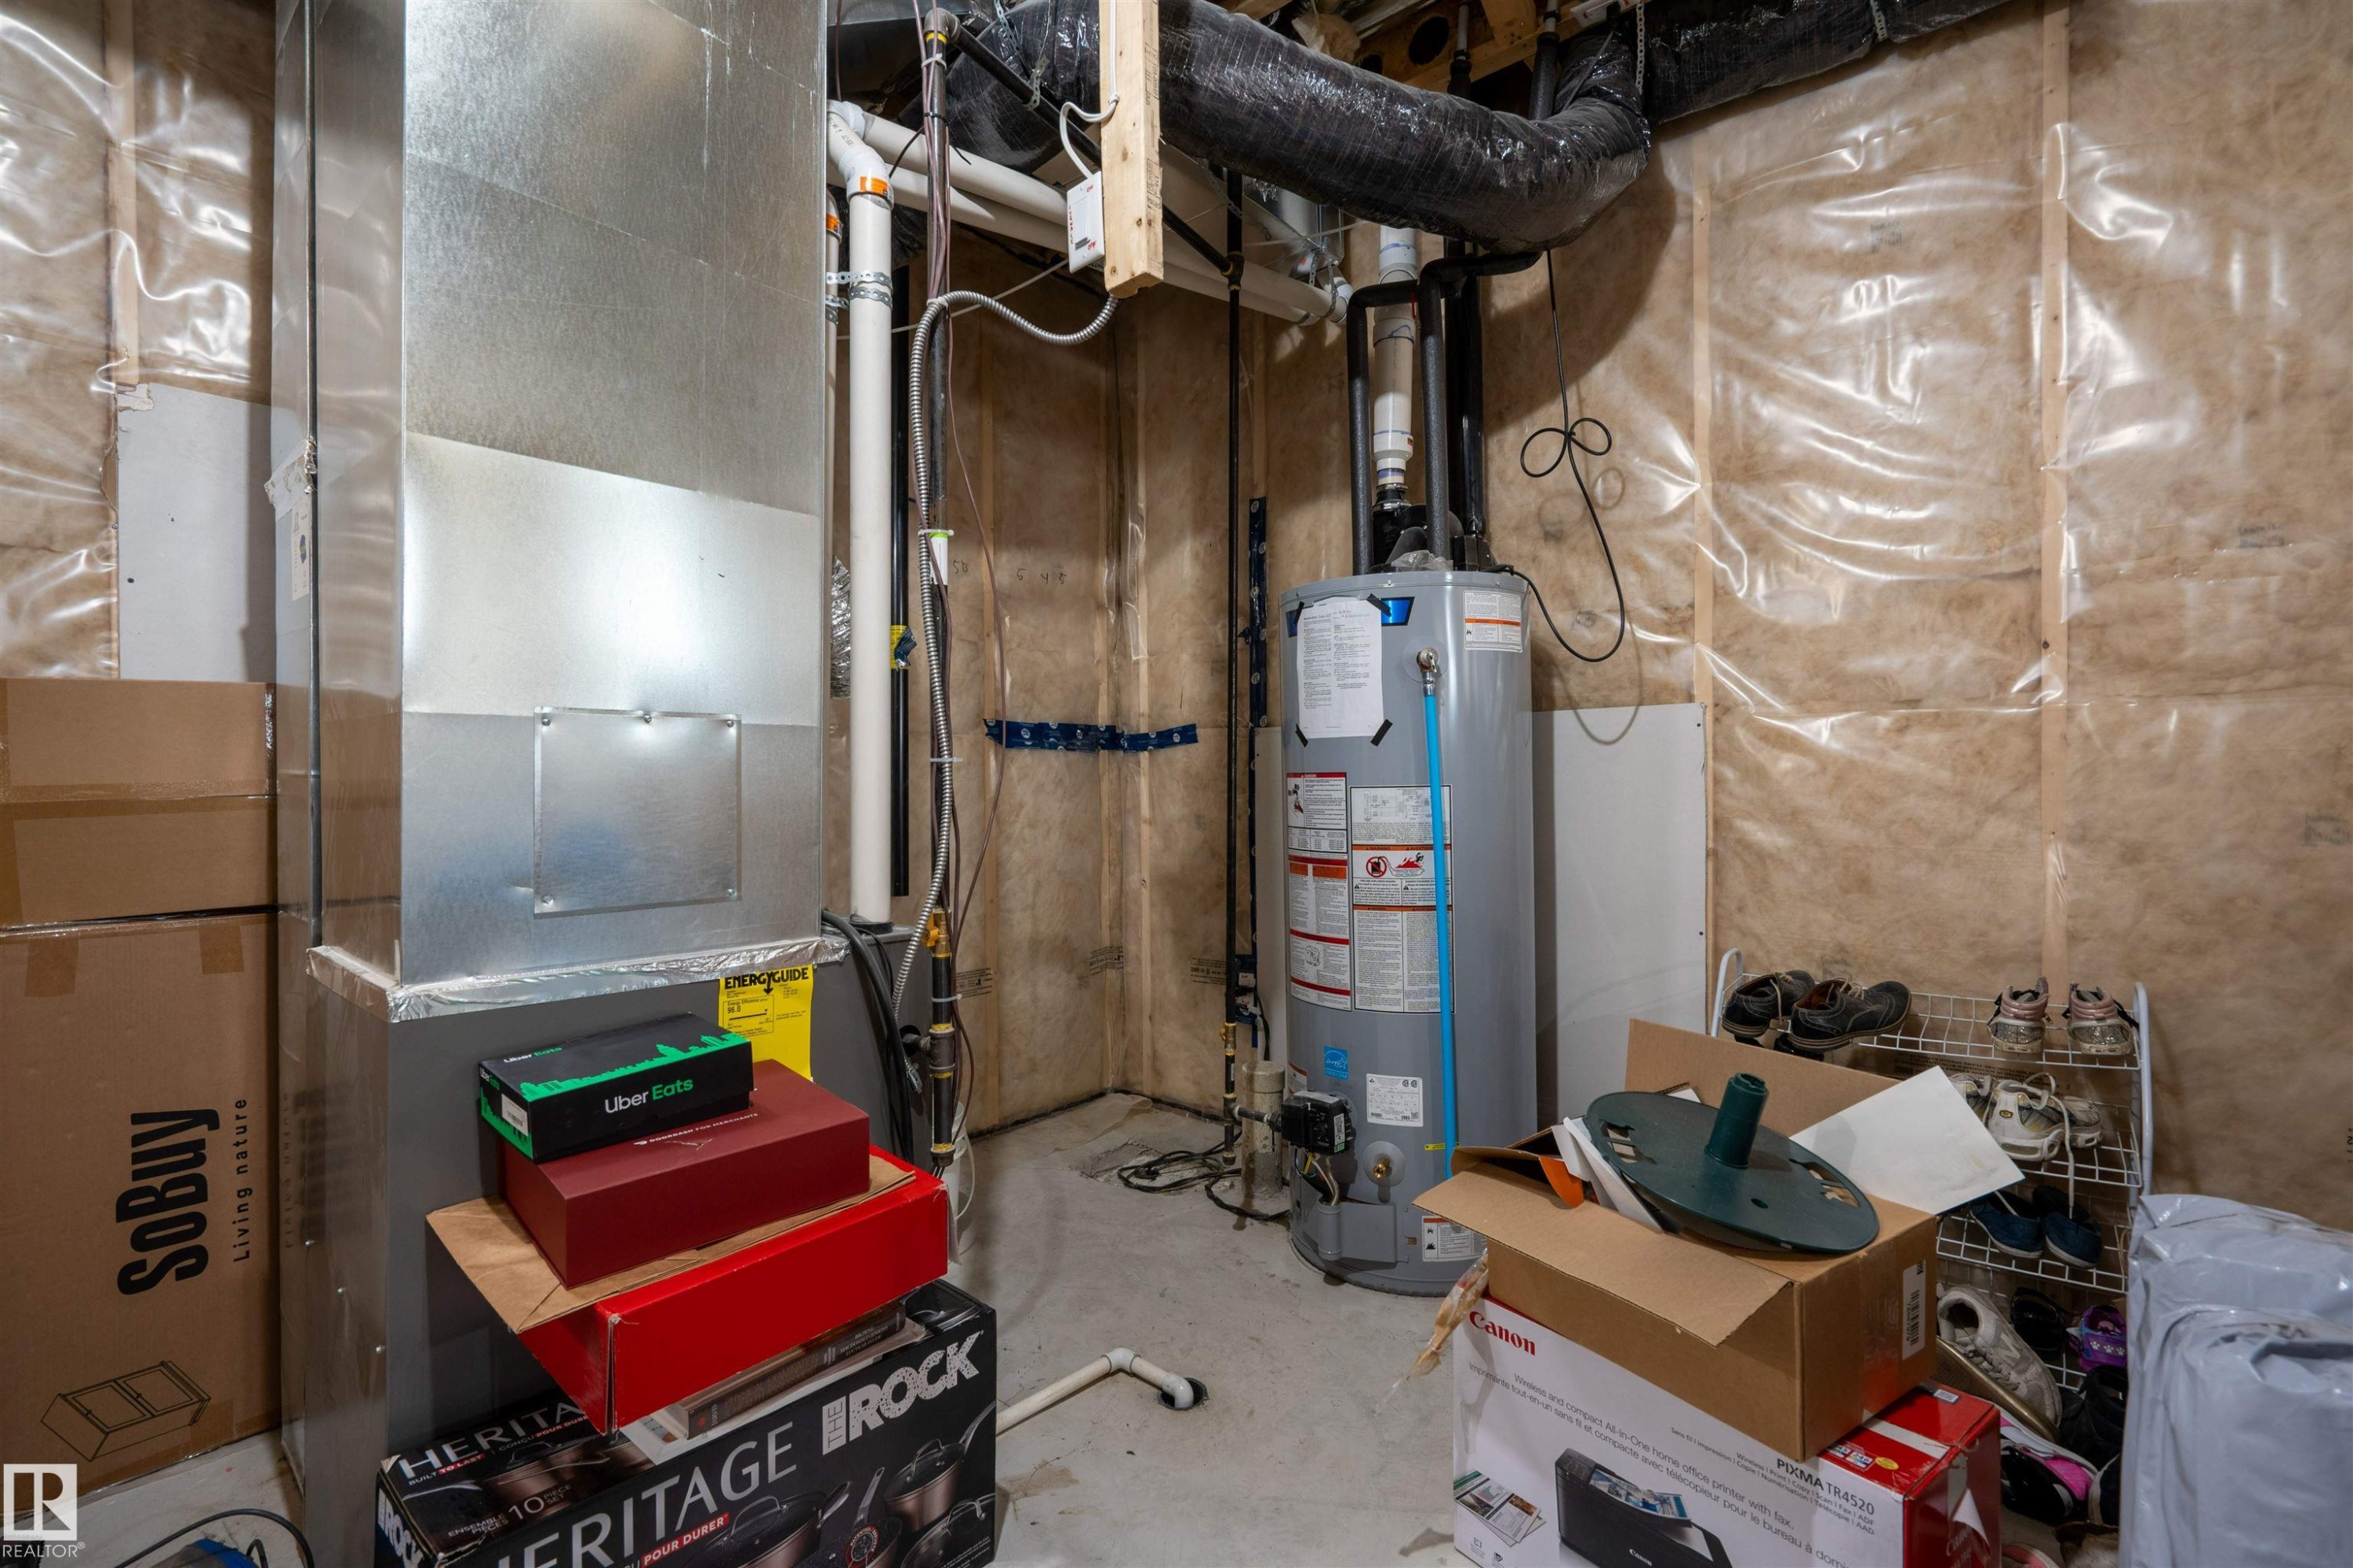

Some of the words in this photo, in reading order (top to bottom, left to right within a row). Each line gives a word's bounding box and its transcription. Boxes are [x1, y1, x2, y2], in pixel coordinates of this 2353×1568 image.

[504, 1053, 532, 1063] Uber
[533, 1047, 562, 1057] Eats
[605, 1091, 649, 1114] Uber
[652, 1078, 693, 1101] Eats
[232, 1098, 249, 1175] nature
[649, 1130, 693, 1142] DOORDASH
[713, 1112, 758, 1126] MERCHANTS
[232, 1187, 253, 1262] Living
[1469, 1311, 1536, 1355] Canon
[827, 1401, 843, 1449] THE
[849, 1331, 980, 1442] ROCK
[399, 1402, 586, 1479] HERITA
[536, 1425, 562, 1437] POUR
[1514, 1373, 1547, 1397] Wireless
[1548, 1393, 1564, 1407] and
[1566, 1402, 1603, 1428] compact
[1605, 1421, 1650, 1450] All-In-One
[1653, 1444, 1680, 1467] home
[1682, 1460, 1709, 1483] office
[1712, 1479, 1745, 1503] printer
[1748, 1497, 1771, 1517] with
[1774, 1509, 1795, 1530] fax.
[409, 1472, 438, 1485] BUILT
[440, 1464, 456, 1475] TO
[456, 1455, 484, 1468] LAST
[1469, 1361, 1510, 1390] Imprimante
[1511, 1384, 1552, 1413] tout-en-un
[1554, 1410, 1574, 1424] sans
[1584, 1423, 1593, 1435] et
[1595, 1430, 1639, 1460] compacte
[1641, 1455, 1664, 1472] avec
[1666, 1468, 1720, 1504] télécopieur
[1723, 1499, 1747, 1518] pour
[1750, 1511, 1760, 1525] le
[1762, 1520, 1802, 1549] bureau
[1806, 1541, 1813, 1555] à
[1671, 1427, 1686, 1439] Sans
[1697, 1439, 1732, 1462] Impression
[1737, 1460, 1757, 1475] Copie
[1762, 1472, 1809, 1502] Numérisation
[1856, 1521, 1875, 1535] AAD
[1736, 1452, 1765, 1472] Wireless
[1769, 1468, 1787, 1483] Print
[1792, 1479, 1810, 1495] Copy
[1816, 1492, 1833, 1506] Scan
[1838, 1503, 1852, 1516] Fax
[1858, 1512, 1875, 1526] ADF
[1777, 1458, 1824, 1491] PIXMA
[1826, 1482, 1875, 1515] TR4520
[448, 1512, 505, 1537] ENSEMBLE
[508, 1496, 545, 1520] 10
[643, 1539, 679, 1566] POUR
[1629, 1548, 1653, 1566] Canon
